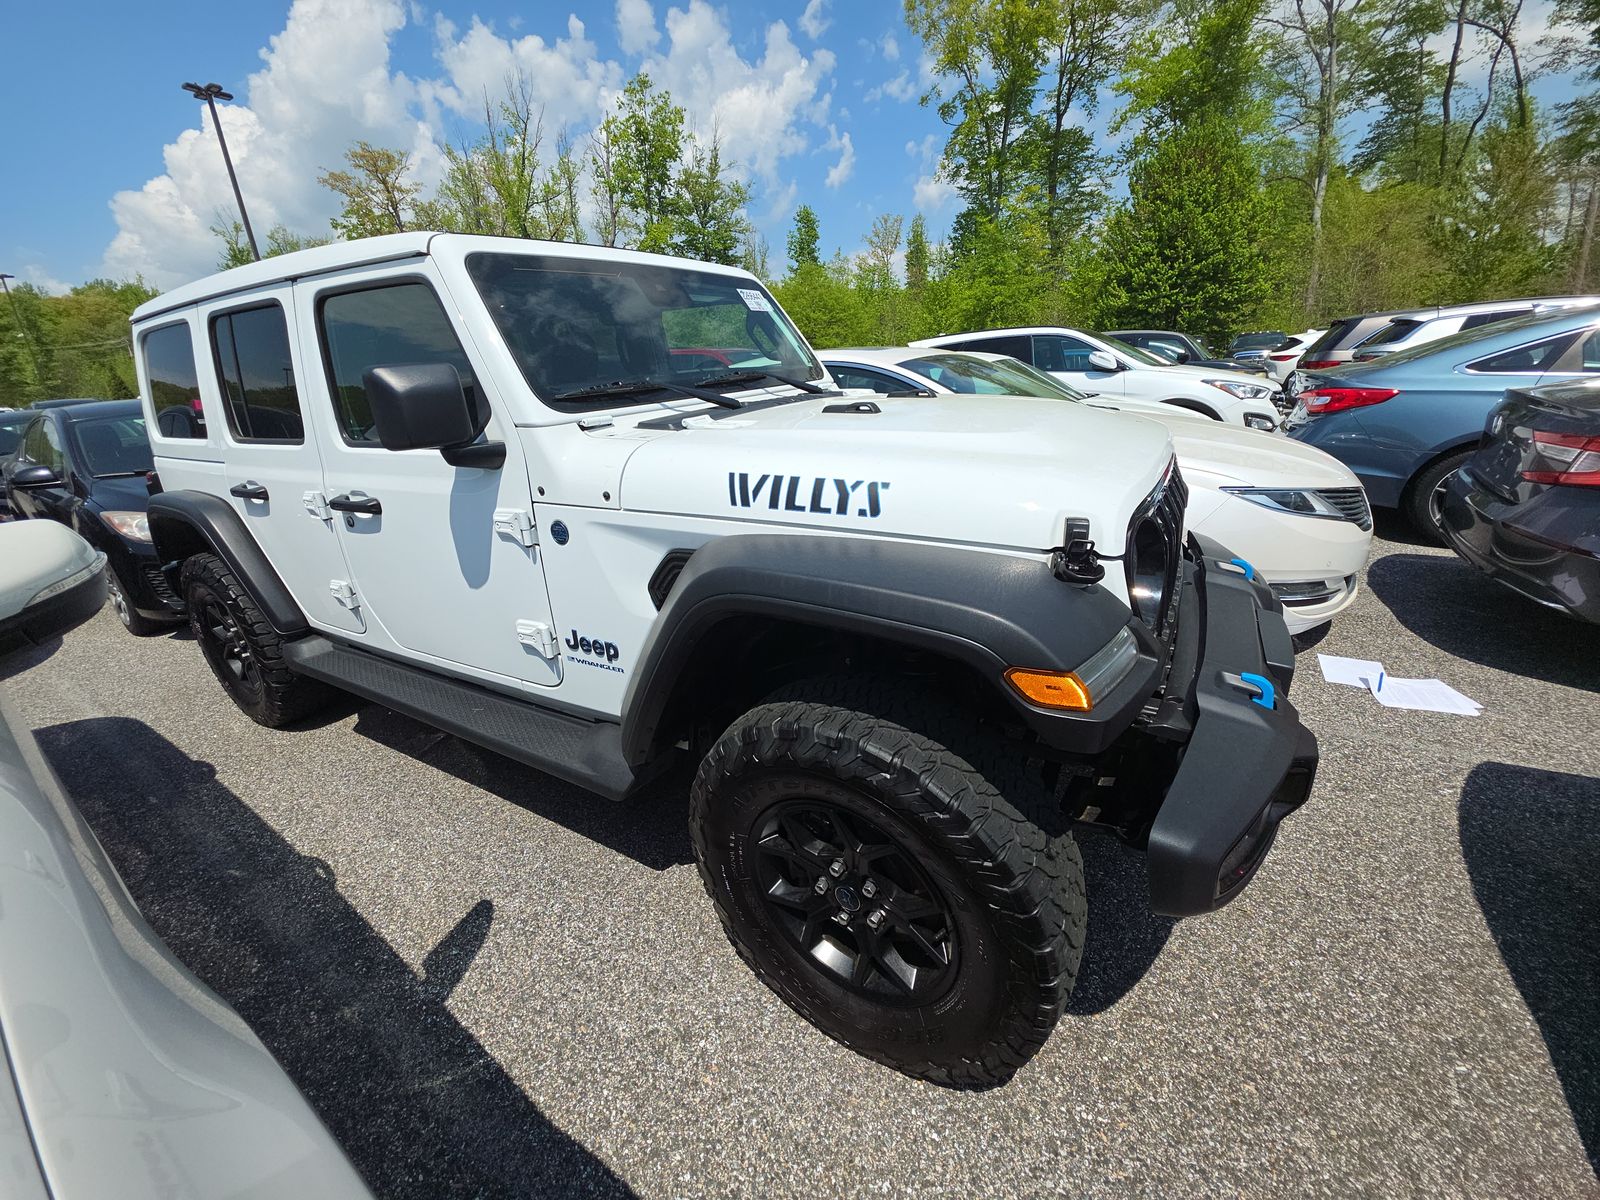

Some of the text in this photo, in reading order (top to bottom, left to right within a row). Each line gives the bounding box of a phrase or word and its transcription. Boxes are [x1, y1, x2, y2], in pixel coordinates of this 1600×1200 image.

[728, 472, 891, 518] WILLYS
[565, 629, 619, 664] Jeep
[575, 657, 625, 673] WRANGLER
